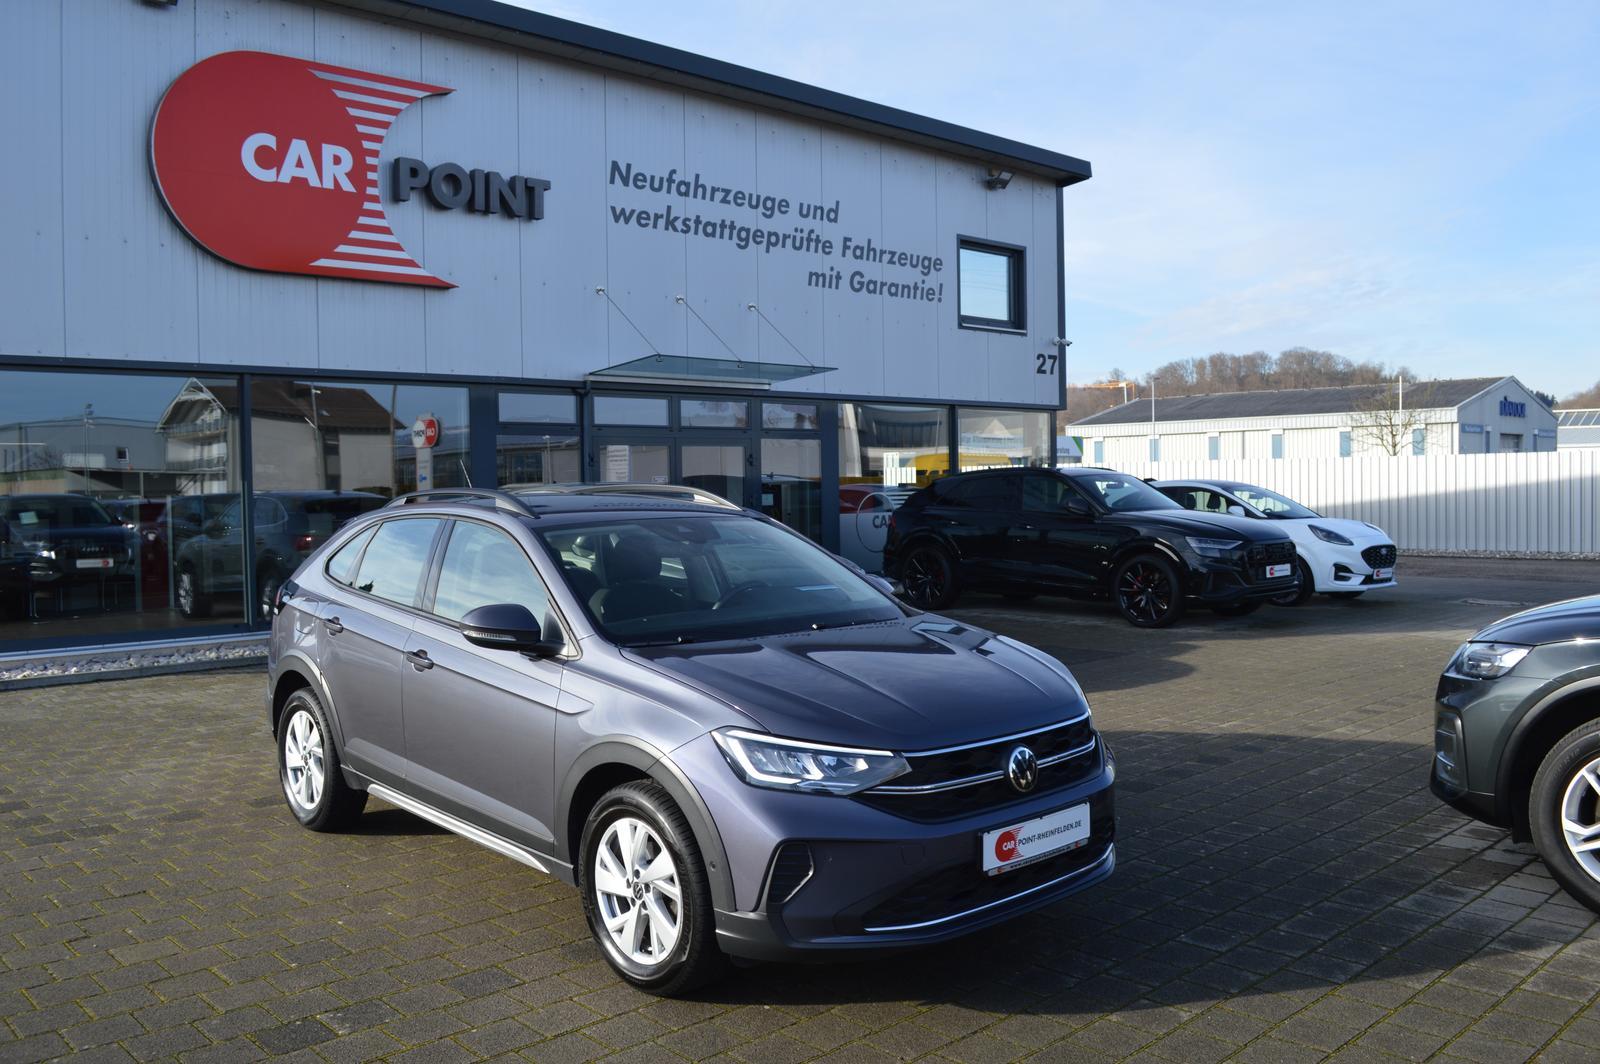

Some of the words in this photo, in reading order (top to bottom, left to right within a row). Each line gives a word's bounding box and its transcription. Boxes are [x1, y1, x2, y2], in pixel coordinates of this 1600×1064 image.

[241, 132, 357, 193] CAR
[394, 157, 551, 220] POINT
[609, 160, 790, 219] Neufahrzeuge
[798, 200, 840, 224] und
[610, 205, 834, 254] werkstattgeprüfte
[841, 236, 943, 276] Fahrzeuge
[808, 266, 842, 290] mit
[849, 270, 943, 303] Garantie!
[1036, 353, 1058, 375] 27
[1002, 841, 1015, 851] CAR
[1017, 820, 1082, 846] POINT-RHEINFELDEN.DE
